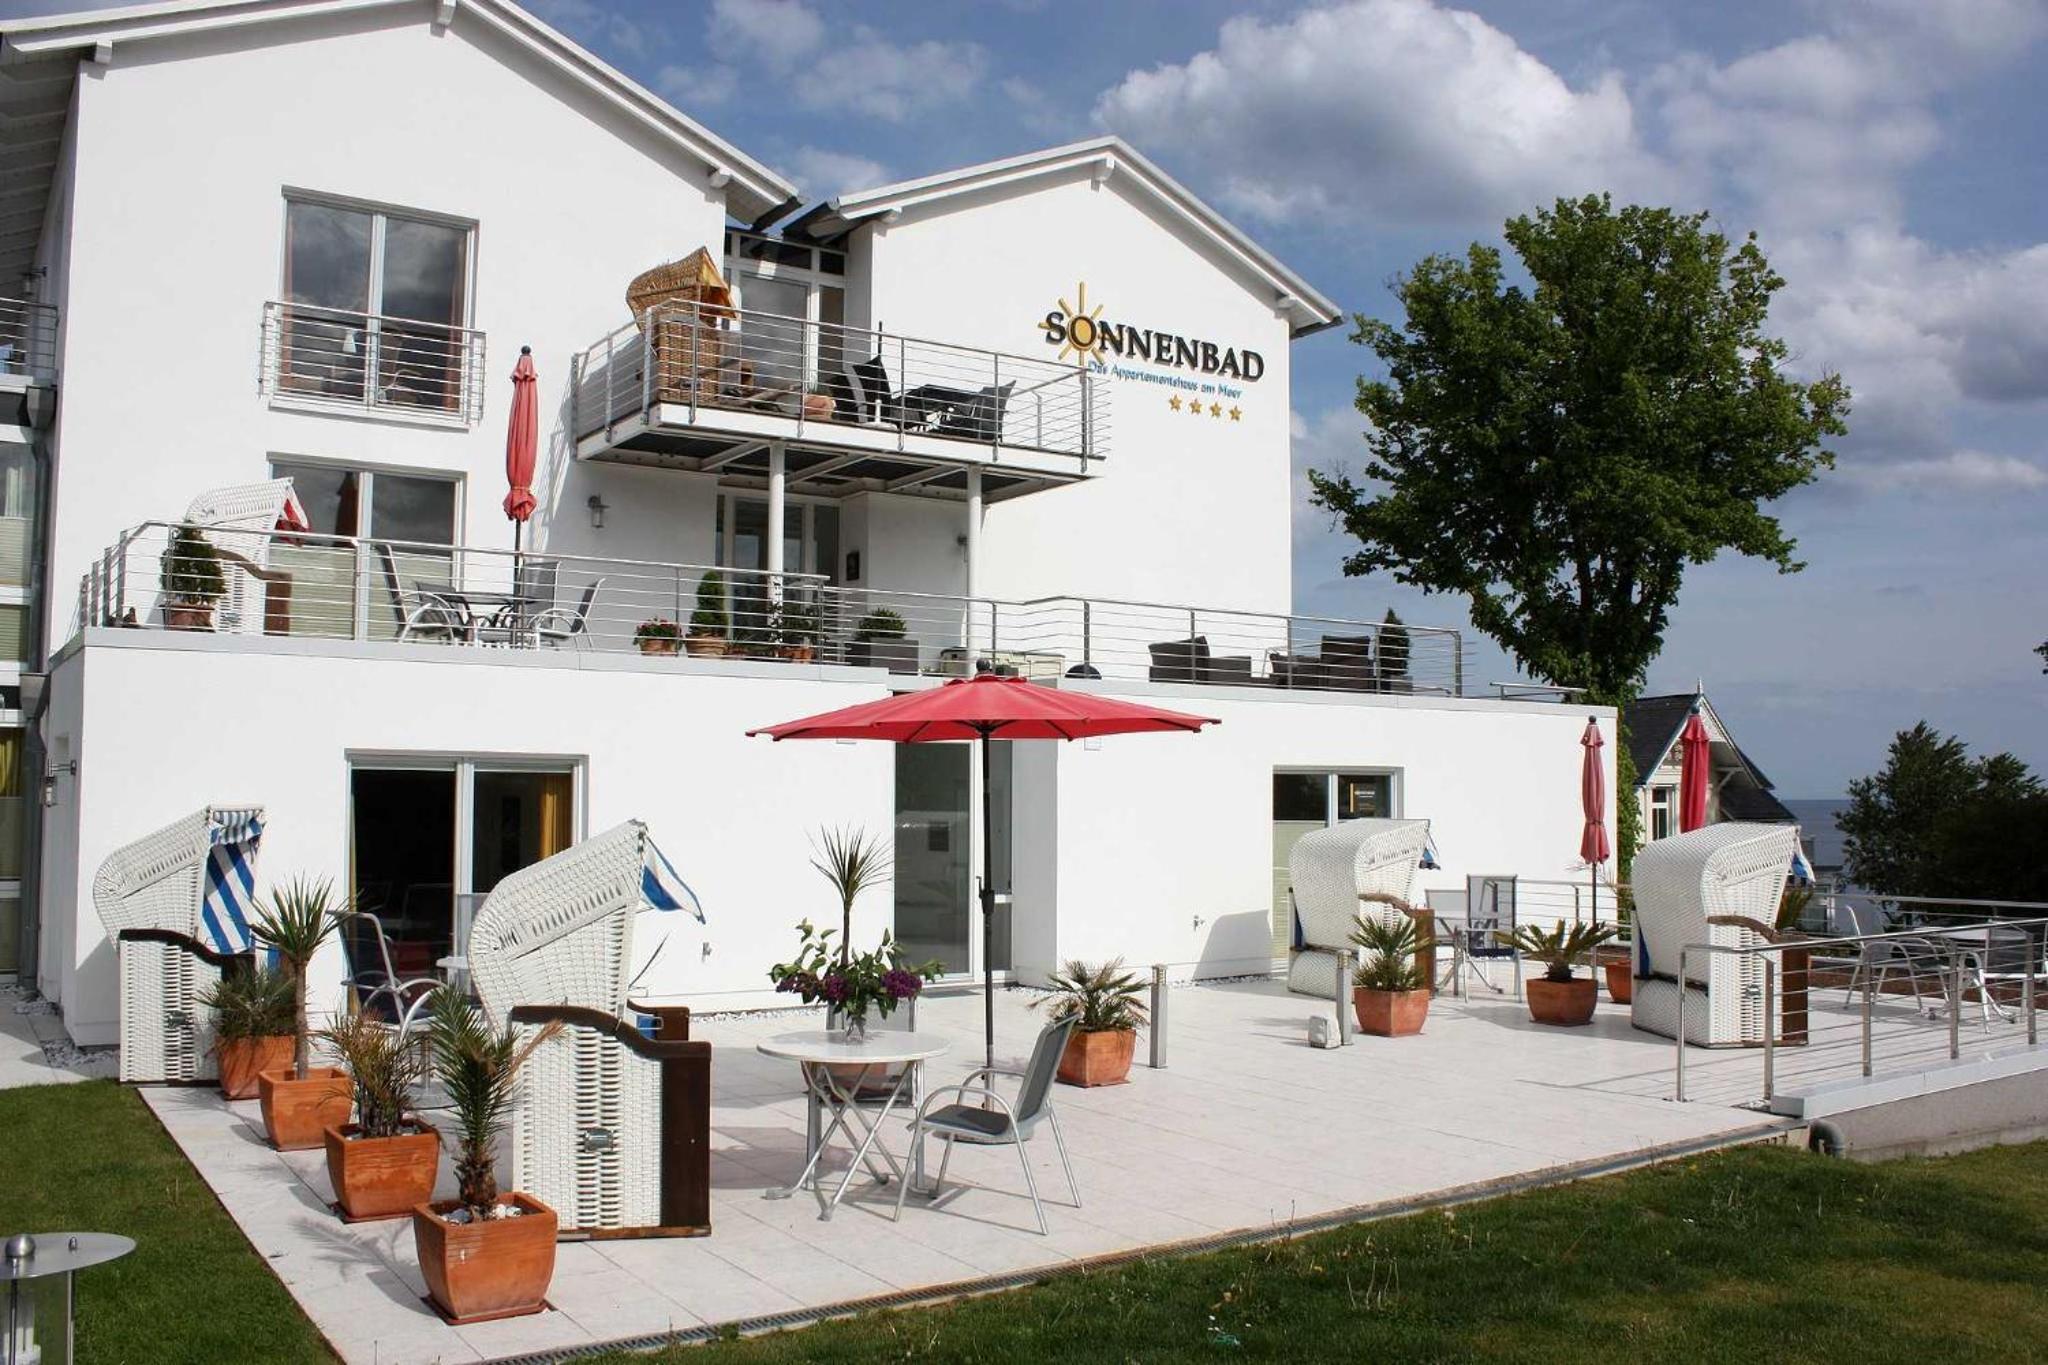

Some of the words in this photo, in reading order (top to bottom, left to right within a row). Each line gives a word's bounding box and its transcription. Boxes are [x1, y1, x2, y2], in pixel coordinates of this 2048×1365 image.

[1045, 311, 1265, 383] SONNENBAD
[1087, 360, 1108, 375] Das
[1111, 364, 1199, 392] Appartementshaus
[1200, 383, 1216, 395] am
[1217, 383, 1243, 398] Meer
